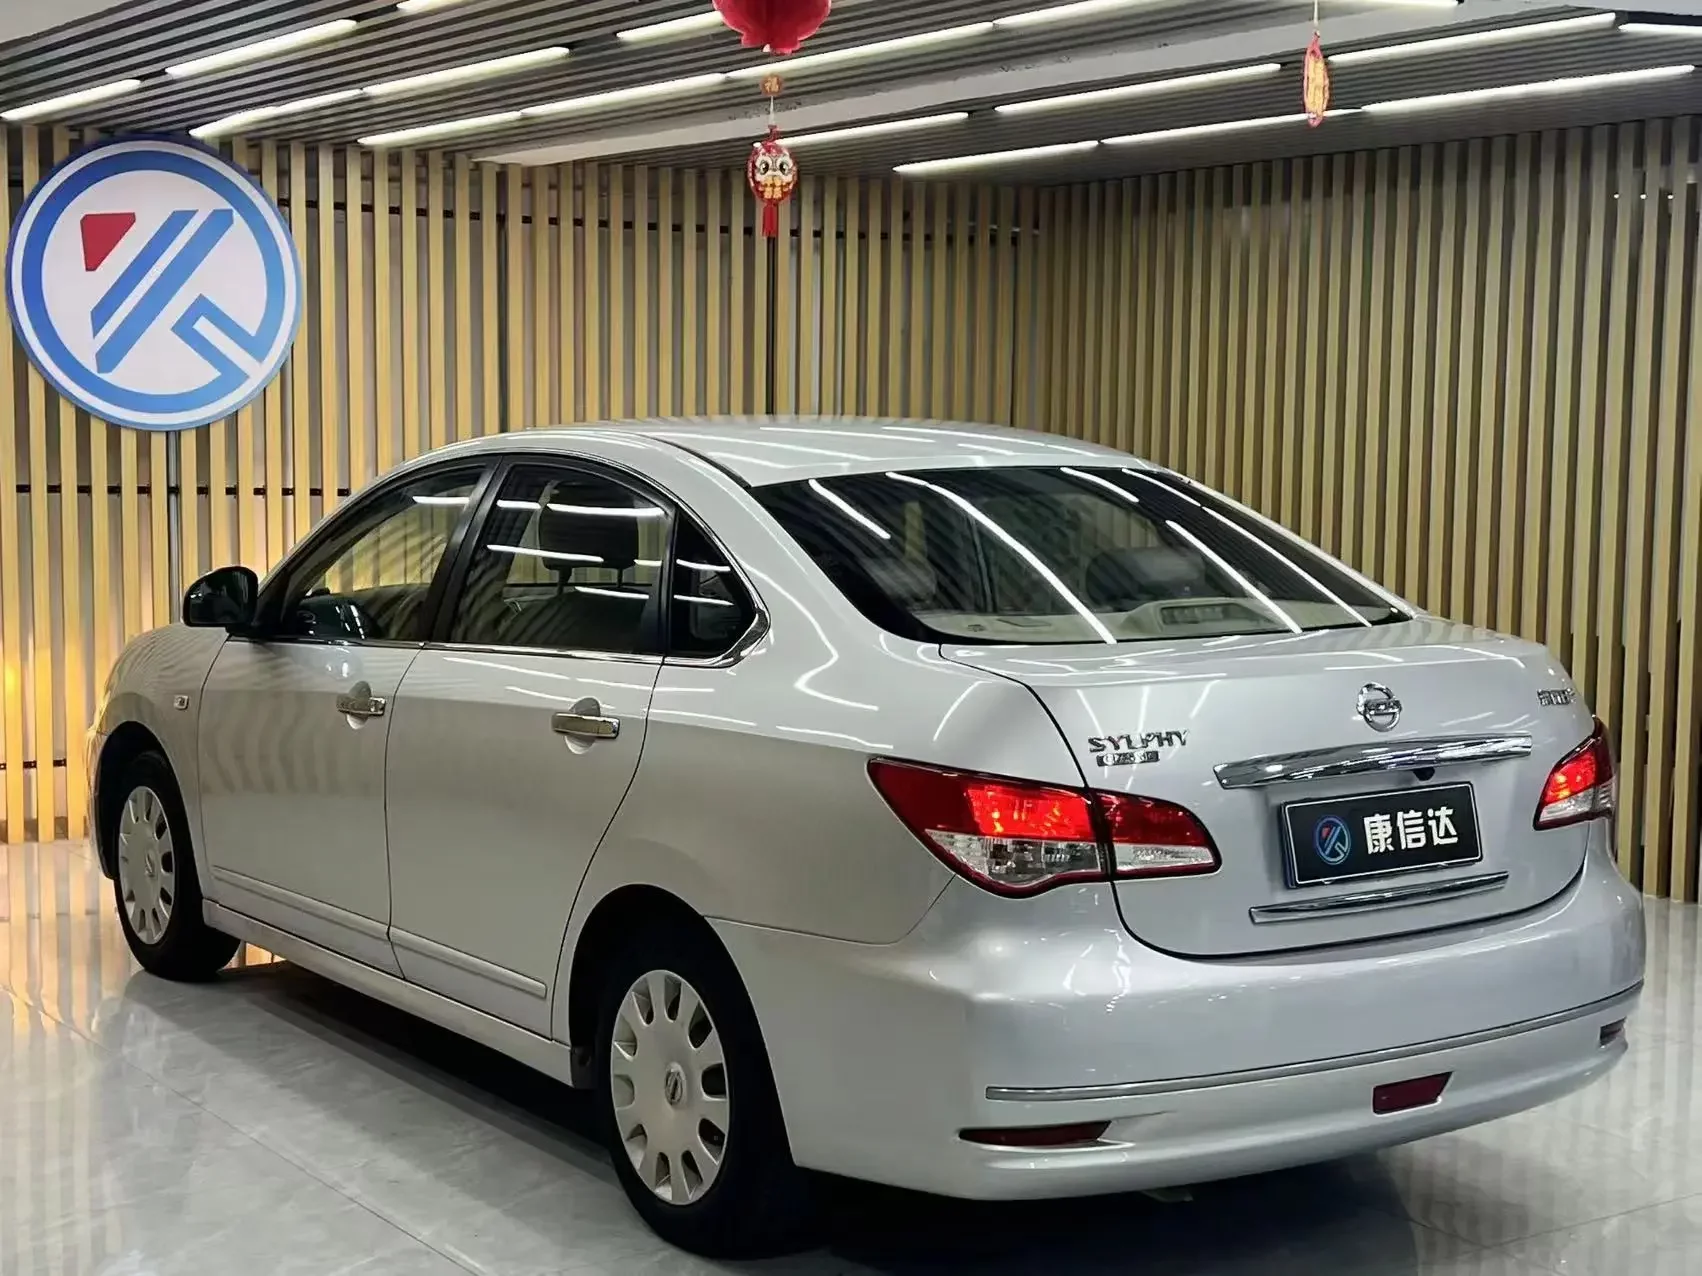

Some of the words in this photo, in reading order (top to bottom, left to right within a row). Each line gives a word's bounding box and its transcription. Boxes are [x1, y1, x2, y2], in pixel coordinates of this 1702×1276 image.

[1088, 729, 1189, 753] SYLPHY
[1363, 806, 1459, 855] 康信达
